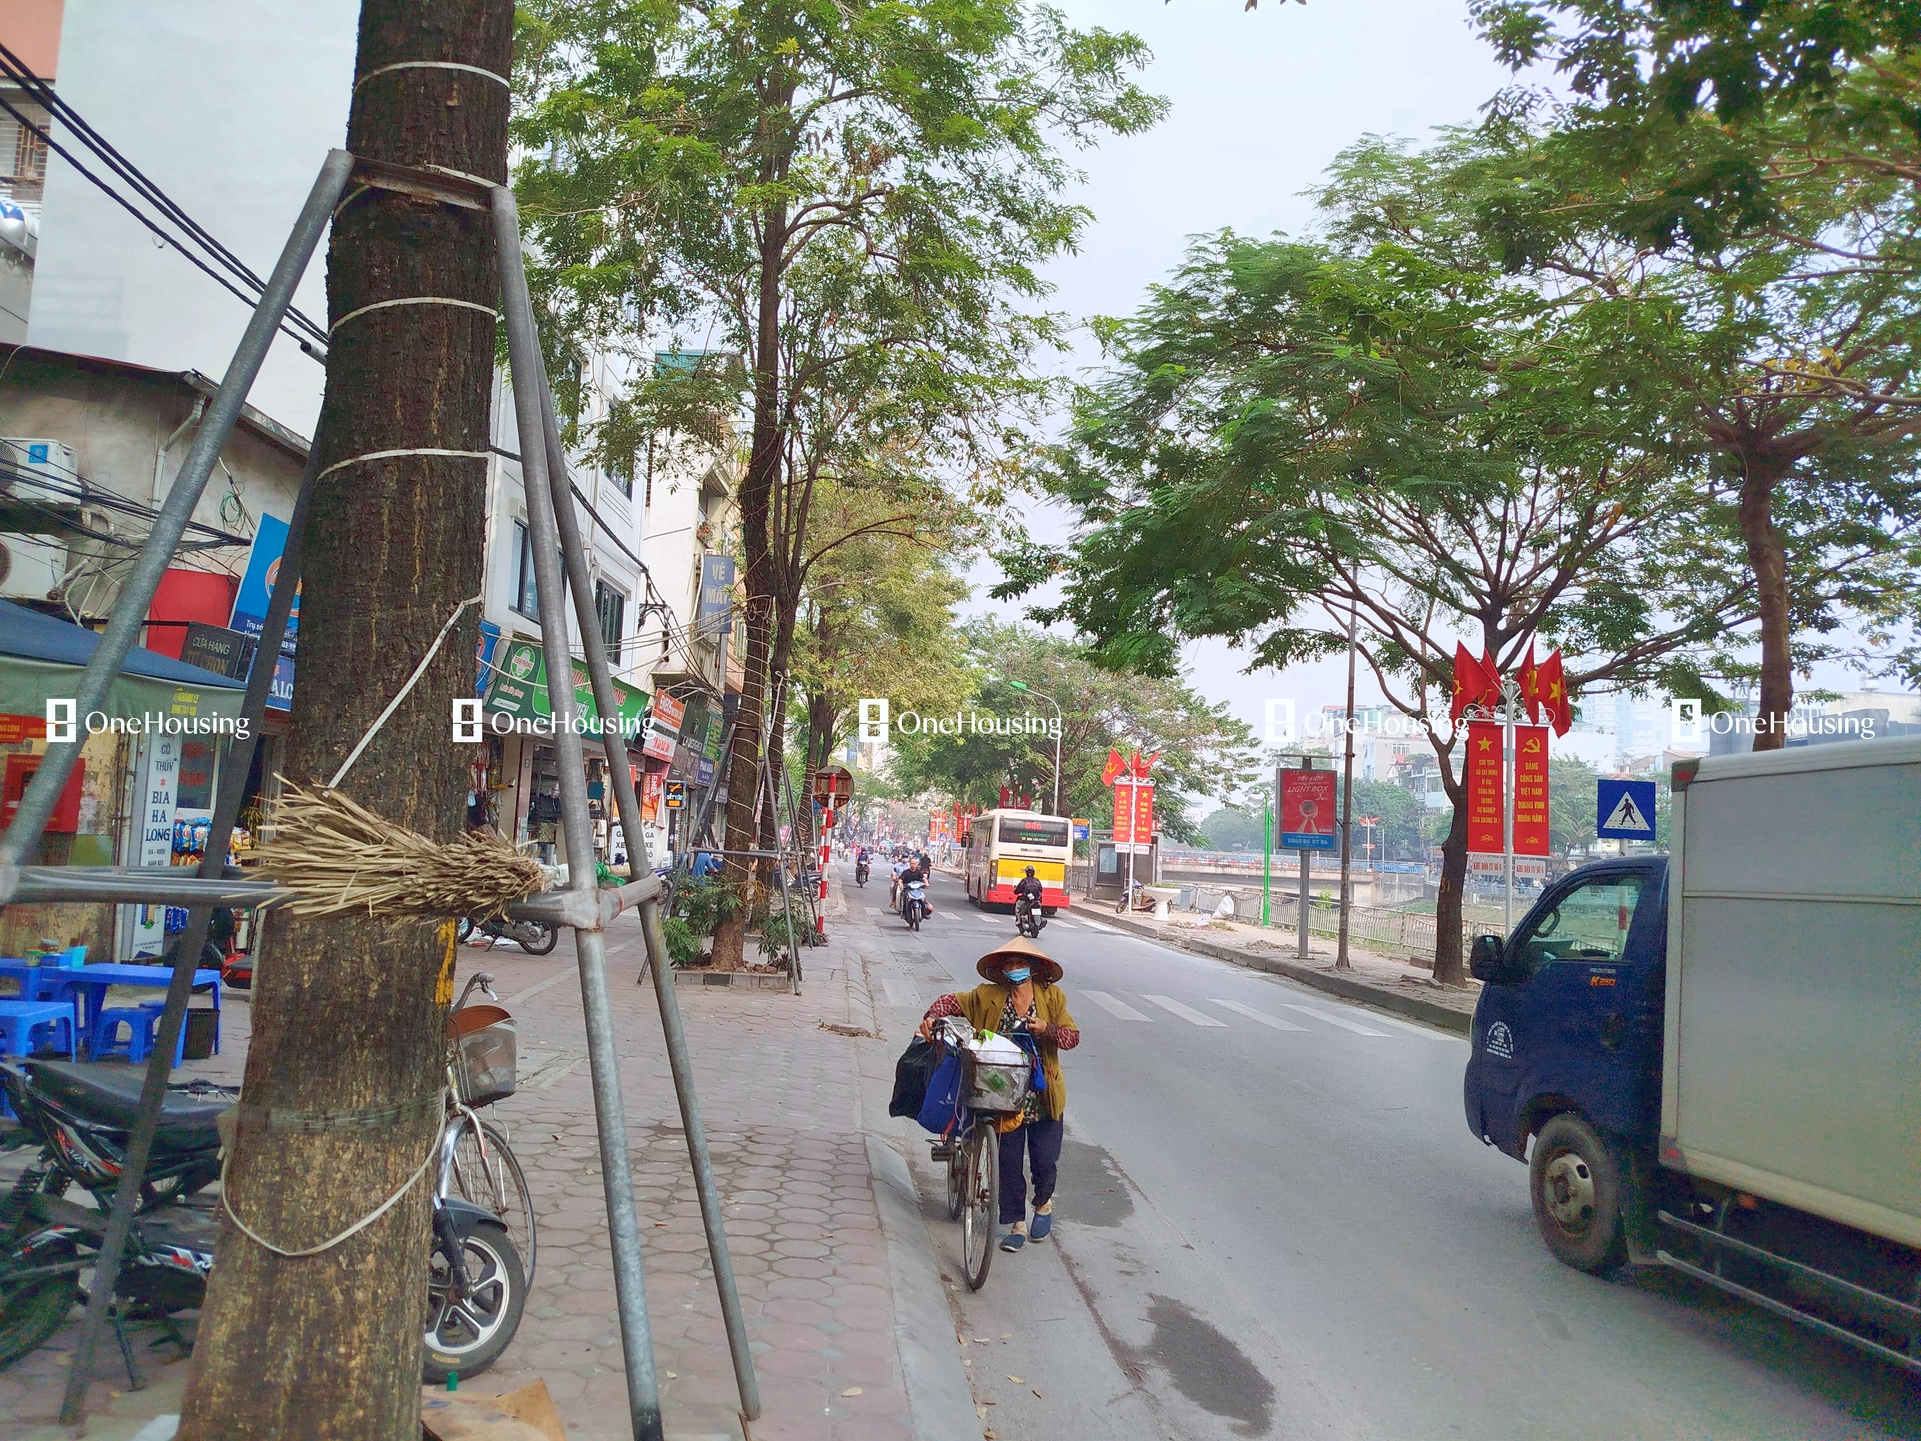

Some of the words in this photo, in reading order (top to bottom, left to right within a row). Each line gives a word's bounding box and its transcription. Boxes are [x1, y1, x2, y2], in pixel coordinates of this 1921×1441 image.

[712, 562, 726, 581] VÉ
[208, 638, 231, 655] HÀNG
[161, 743, 171, 755] CÔ
[1524, 760, 1539, 771] ĐẢNG
[1519, 773, 1533, 784] CỘNG
[1533, 772, 1544, 783] SẢN
[1287, 785, 1312, 793] LIGHT
[1520, 786, 1531, 797] VIỆT
[1531, 787, 1543, 796] NAM
[151, 791, 170, 804] BIA
[1517, 800, 1534, 810] QUANG
[151, 809, 167, 823] HA
[1517, 813, 1531, 823] MUÔN
[145, 828, 171, 842] LONG
